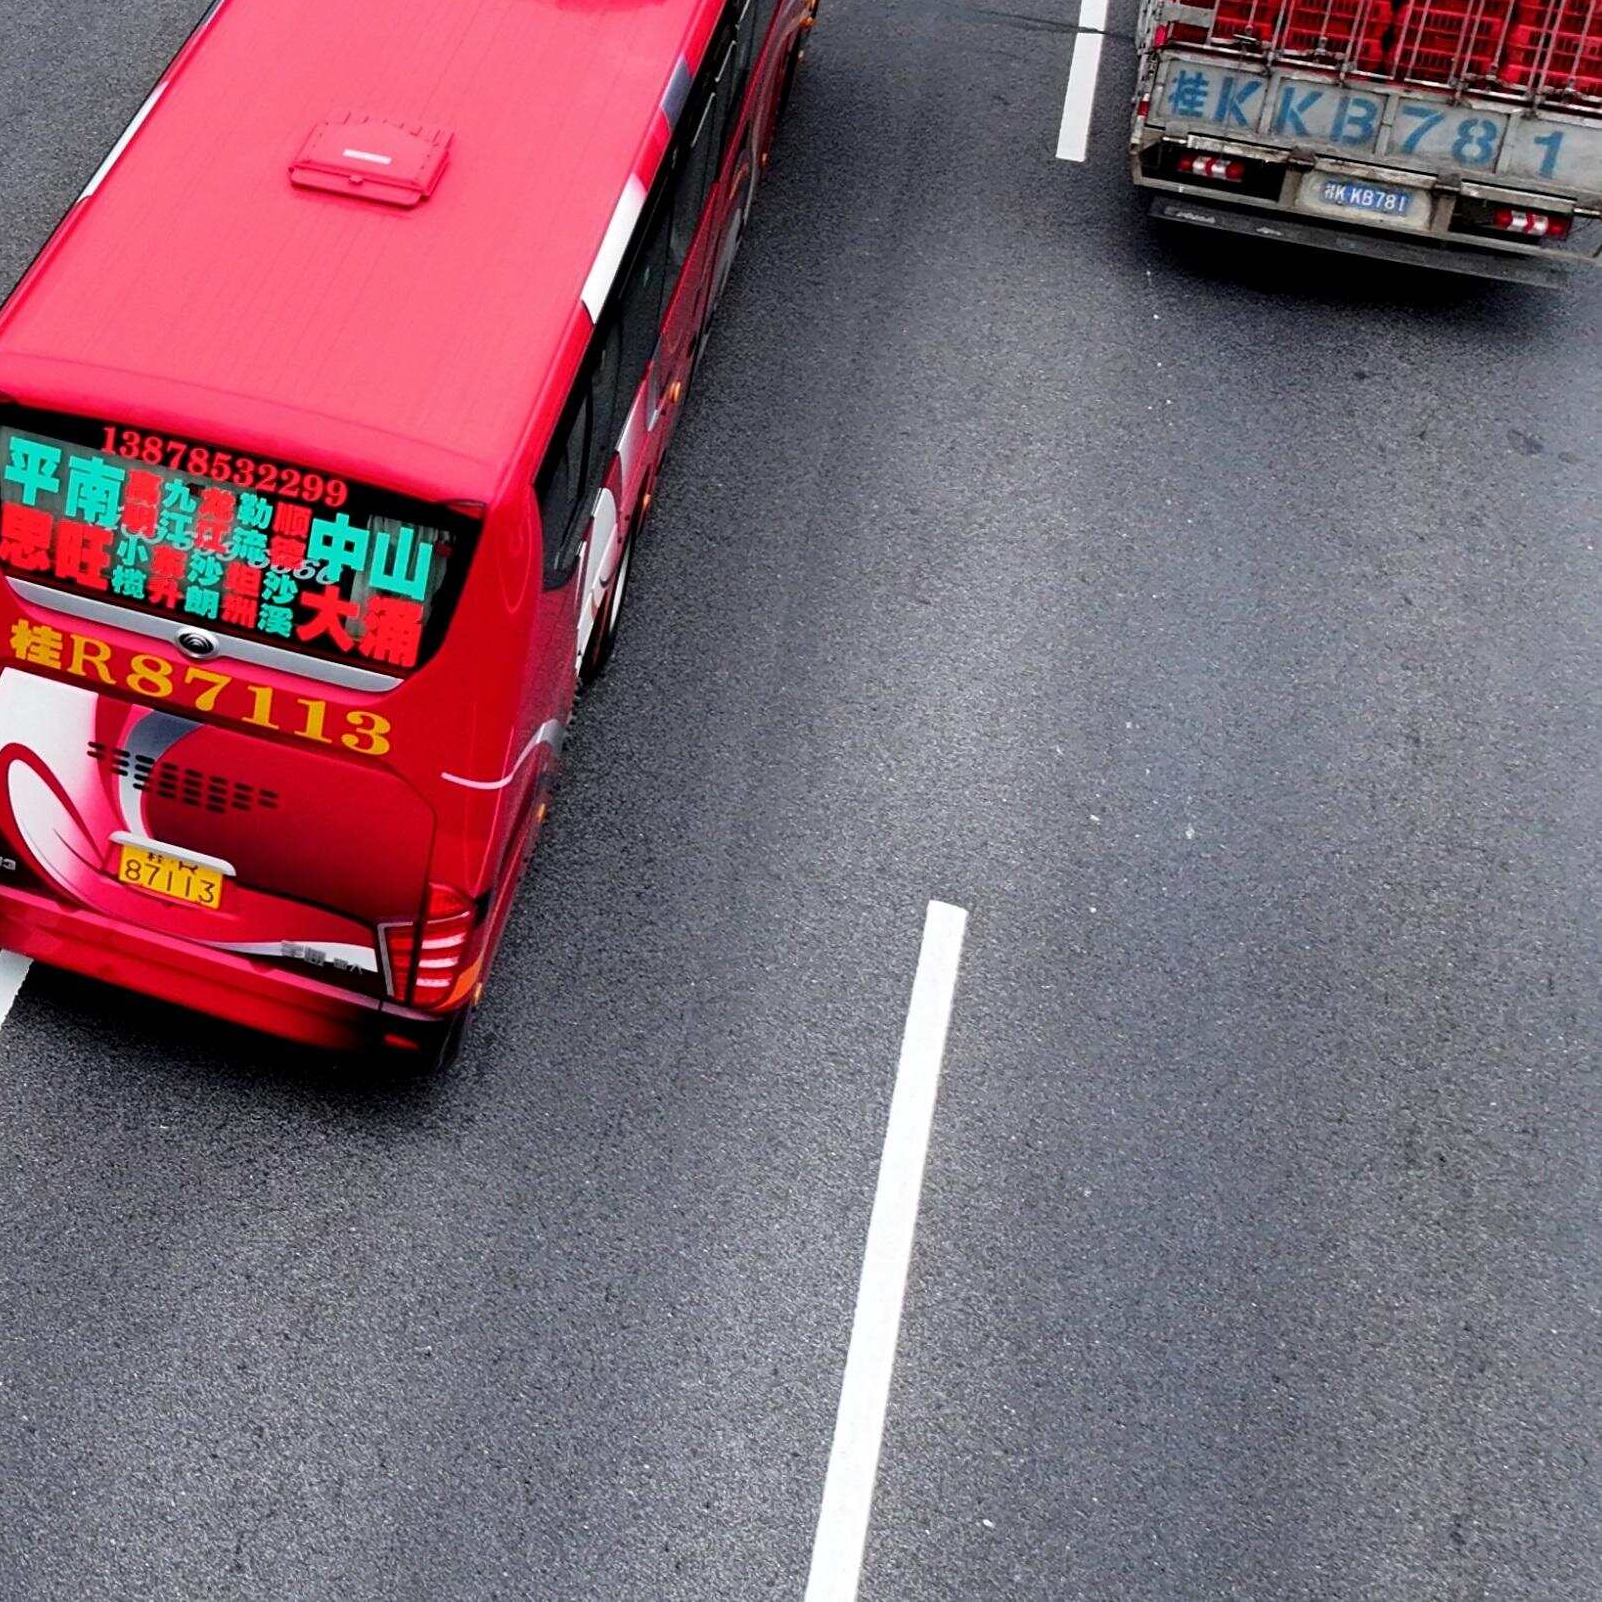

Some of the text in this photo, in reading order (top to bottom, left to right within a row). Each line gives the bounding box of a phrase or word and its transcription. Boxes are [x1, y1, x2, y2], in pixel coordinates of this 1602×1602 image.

[3, 436, 126, 530] 平南
[100, 426, 348, 508] 13878532299
[158, 478, 197, 549] 九江
[307, 512, 434, 602] 中山
[299, 584, 424, 668] 大涌
[9, 618, 393, 755] 桂R87113
[124, 858, 216, 904] 87113
